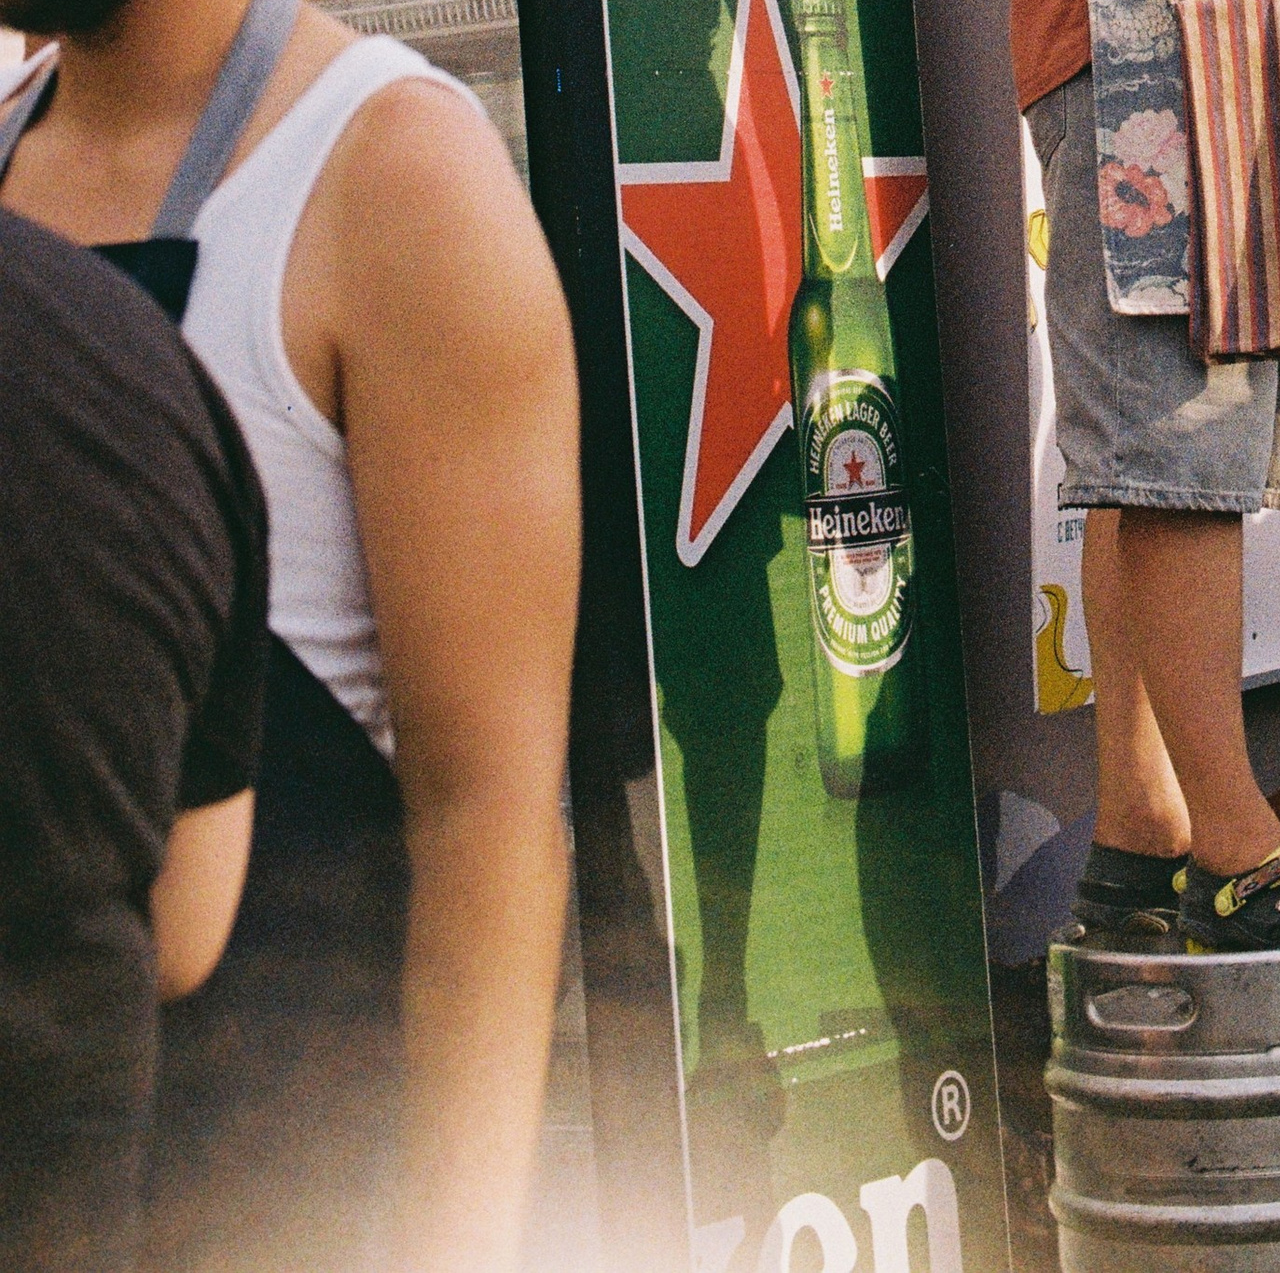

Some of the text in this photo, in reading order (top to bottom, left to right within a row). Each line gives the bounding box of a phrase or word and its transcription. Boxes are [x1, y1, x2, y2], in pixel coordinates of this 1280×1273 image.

[824, 108, 843, 232] Heineken
[809, 399, 897, 475] HEINEKEN LAGER BEER
[809, 501, 906, 541] Heineken
[819, 574, 906, 644] PREMIUM QUALITY
